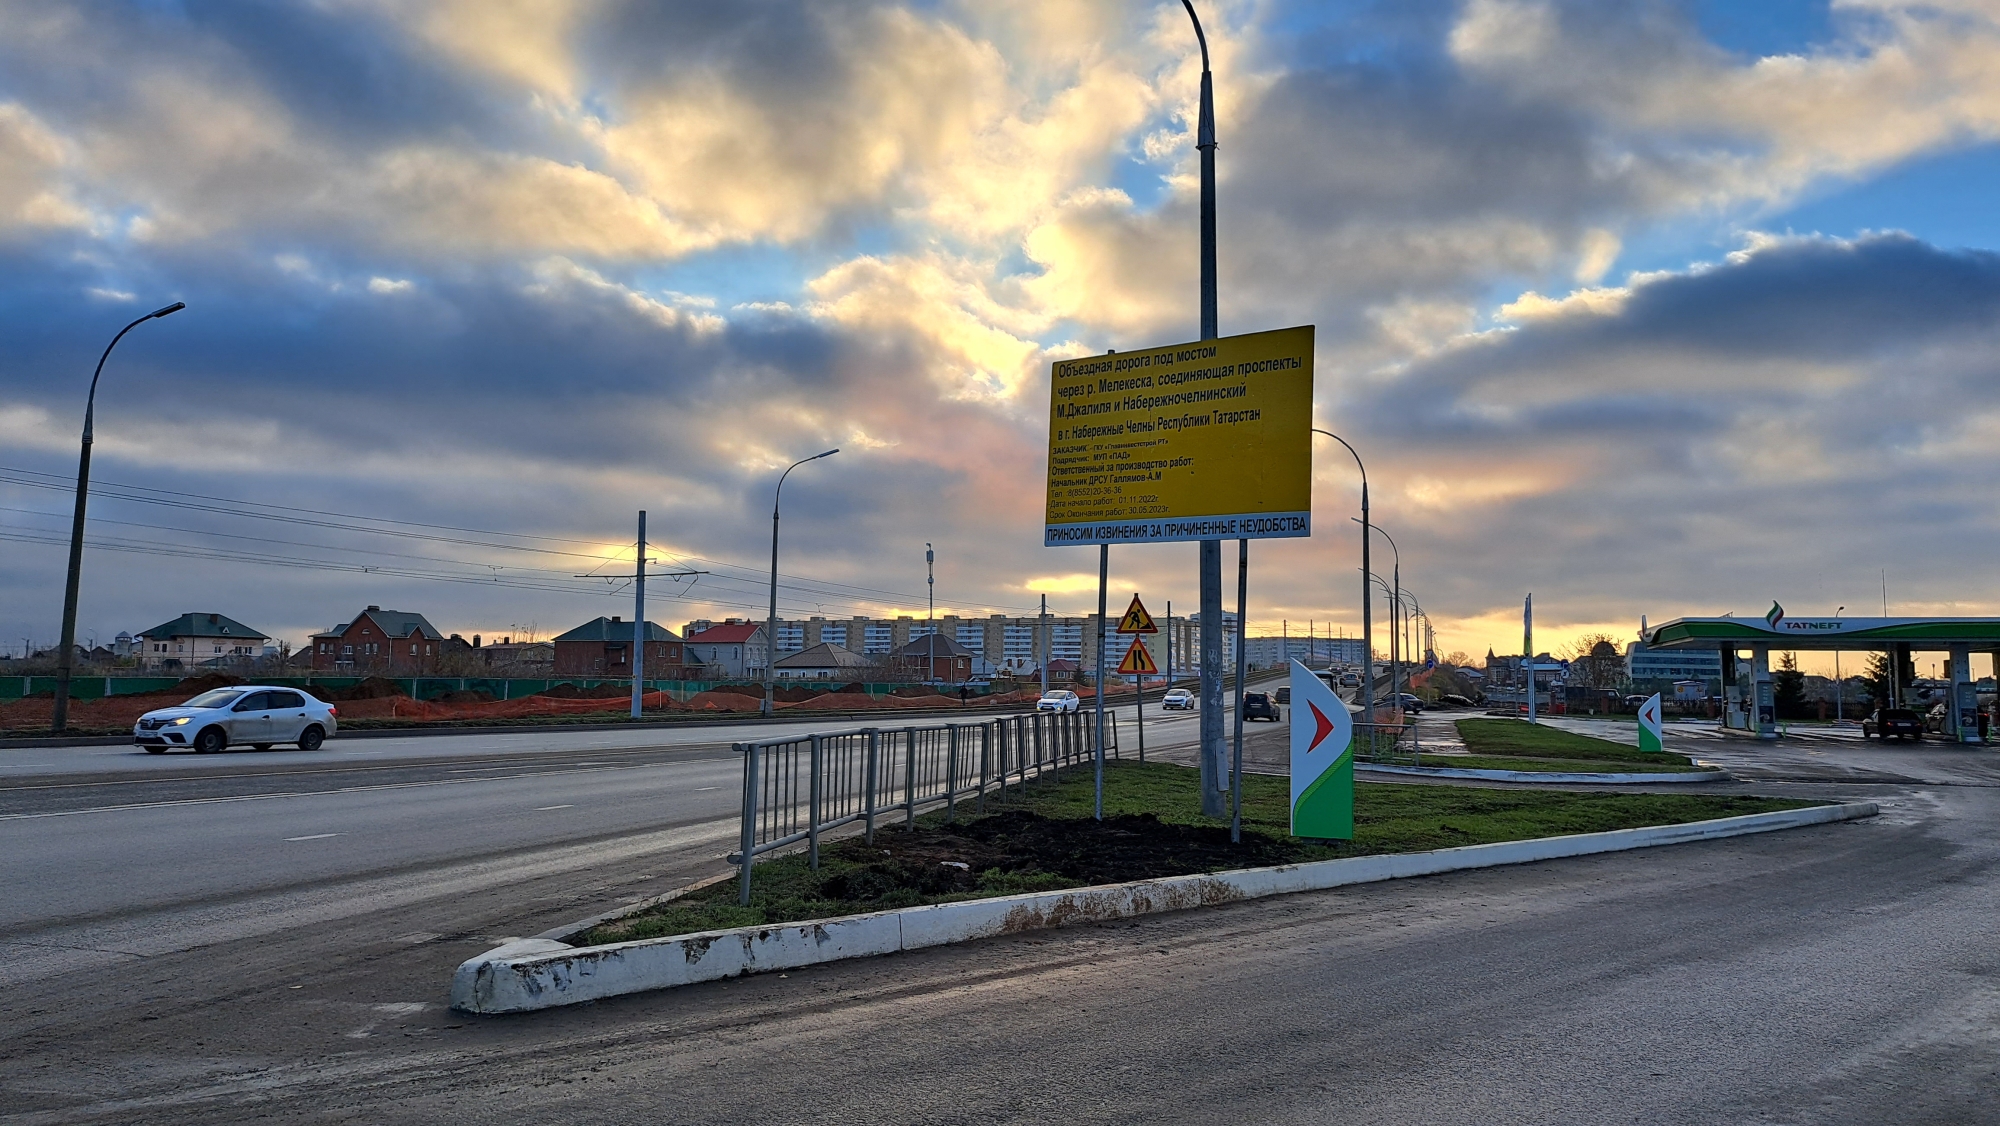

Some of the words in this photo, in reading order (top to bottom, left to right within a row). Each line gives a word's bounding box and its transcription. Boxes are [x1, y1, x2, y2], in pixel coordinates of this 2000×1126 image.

[1058, 361, 1113, 379] Объездная
[1115, 355, 1151, 373] дорога
[1154, 353, 1174, 366] под
[1176, 346, 1217, 363] мостом
[1058, 384, 1085, 400] через
[1087, 384, 1096, 398] р.
[1098, 376, 1154, 394] Мелекеска,
[1158, 365, 1235, 386] соединяющая
[1237, 356, 1302, 378] проспекты
[1056, 402, 1111, 419] М.Джалиля
[1114, 401, 1120, 412] и
[1123, 382, 1246, 411] Набережночелнинский
[1058, 431, 1063, 440] в
[1065, 429, 1070, 440] г.
[1072, 423, 1124, 440] Набережные
[1126, 420, 1155, 434] Челны
[1157, 413, 1210, 432] Республики
[1213, 408, 1261, 426] Татарстан
[1051, 463, 1105, 476] Ответственный
[1106, 463, 1114, 472] за
[1116, 460, 1168, 472] производство
[1170, 456, 1194, 468] работ:
[1052, 455, 1090, 466] Подрядчик:
[1093, 452, 1108, 461] МУП
[1109, 451, 1131, 460] «ПАД»
[1051, 477, 1088, 488] Начальник
[1088, 474, 1108, 486] ДРСУ
[1049, 500, 1066, 509] Дата
[1049, 510, 1066, 519] Срок
[1066, 509, 1104, 518] Окончания
[1047, 527, 1093, 541] ПРИНОСИМ
[1095, 525, 1148, 540] ИЗВИНЕНИЯ
[1150, 524, 1162, 537] ЗА
[1164, 520, 1237, 538] ПРИЧИНЕННЫЕ
[1239, 516, 1307, 535] НЕУДОБСТВА
[1784, 622, 1843, 630] TATNEFT
